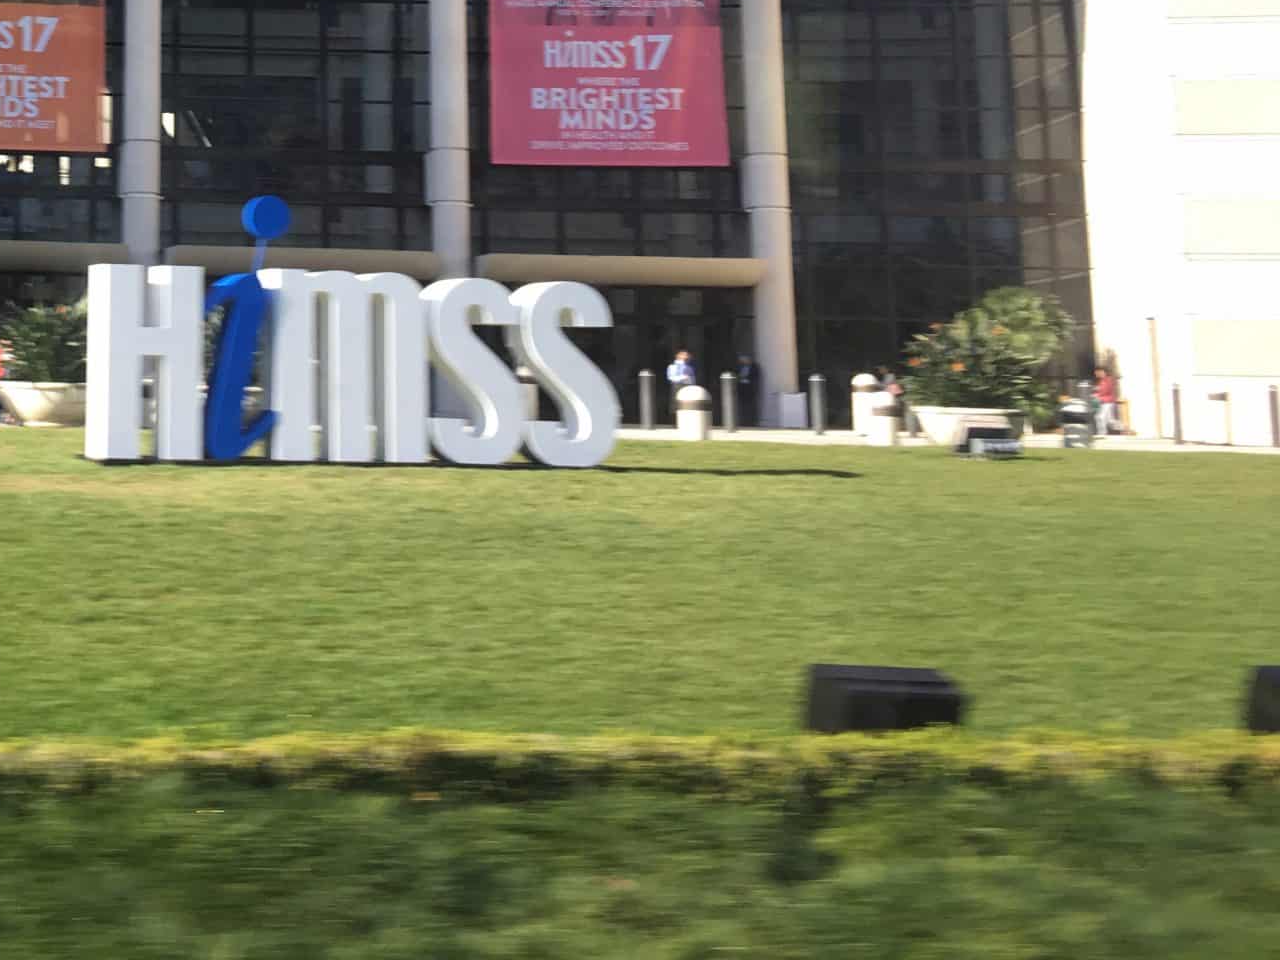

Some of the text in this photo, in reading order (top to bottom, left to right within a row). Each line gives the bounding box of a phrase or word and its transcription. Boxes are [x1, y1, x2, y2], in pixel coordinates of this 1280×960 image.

[17, 15, 60, 53] 17
[630, 34, 673, 70] 17
[3, 64, 27, 73] THE
[530, 87, 686, 111] BRIGHTEST
[559, 109, 657, 131] MINDS
